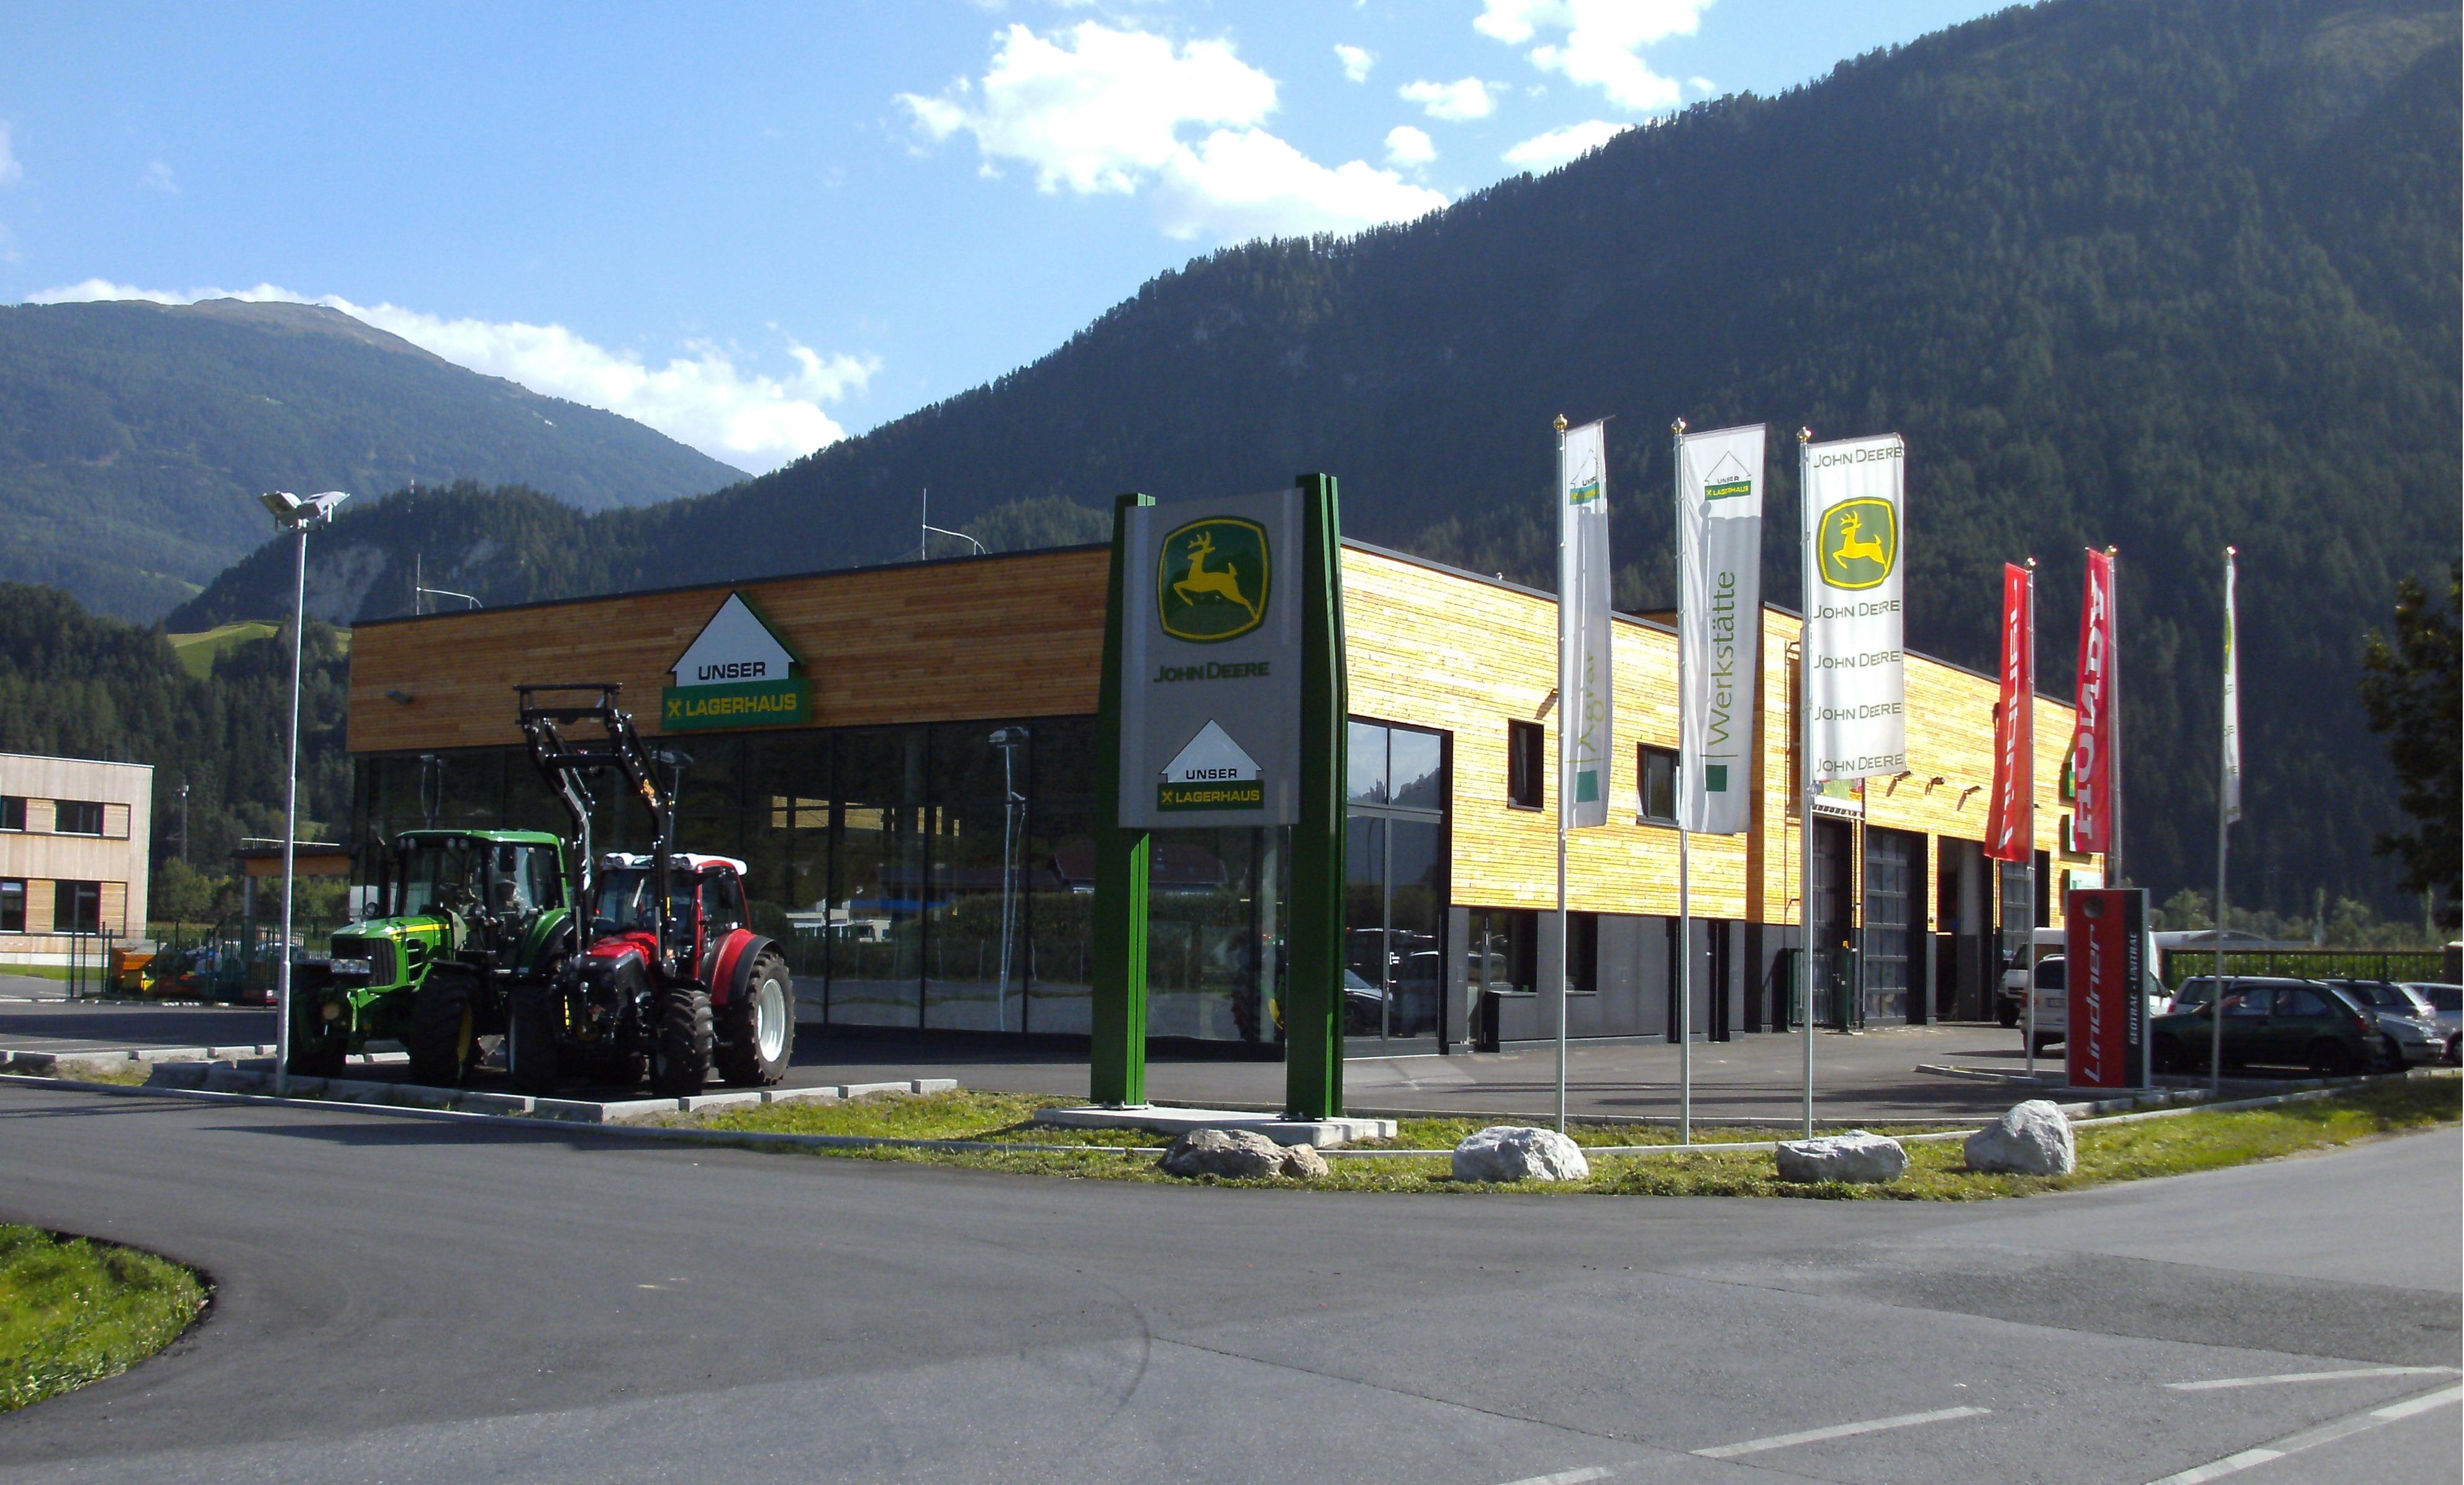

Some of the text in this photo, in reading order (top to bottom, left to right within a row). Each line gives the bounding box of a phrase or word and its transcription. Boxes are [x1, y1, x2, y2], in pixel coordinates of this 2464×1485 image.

[1813, 447, 1903, 468] JOHN DEERE
[1813, 600, 1900, 619] JOHN DEERE
[1707, 571, 1735, 746] Werkstätte
[1814, 651, 1901, 669] JOHN DEERE
[698, 661, 766, 680] UNSER
[1153, 661, 1270, 683] JOHN DEERE
[686, 693, 797, 716] LAGERHAUS
[1578, 651, 1606, 752] Agrar
[1814, 703, 1902, 720] JOHN DEERE
[1817, 754, 1903, 772] JOHN DEERE
[1186, 769, 1238, 780] UNSER
[1175, 790, 1260, 803] LAGERHAUS
[2084, 924, 2100, 1083] Lindner
